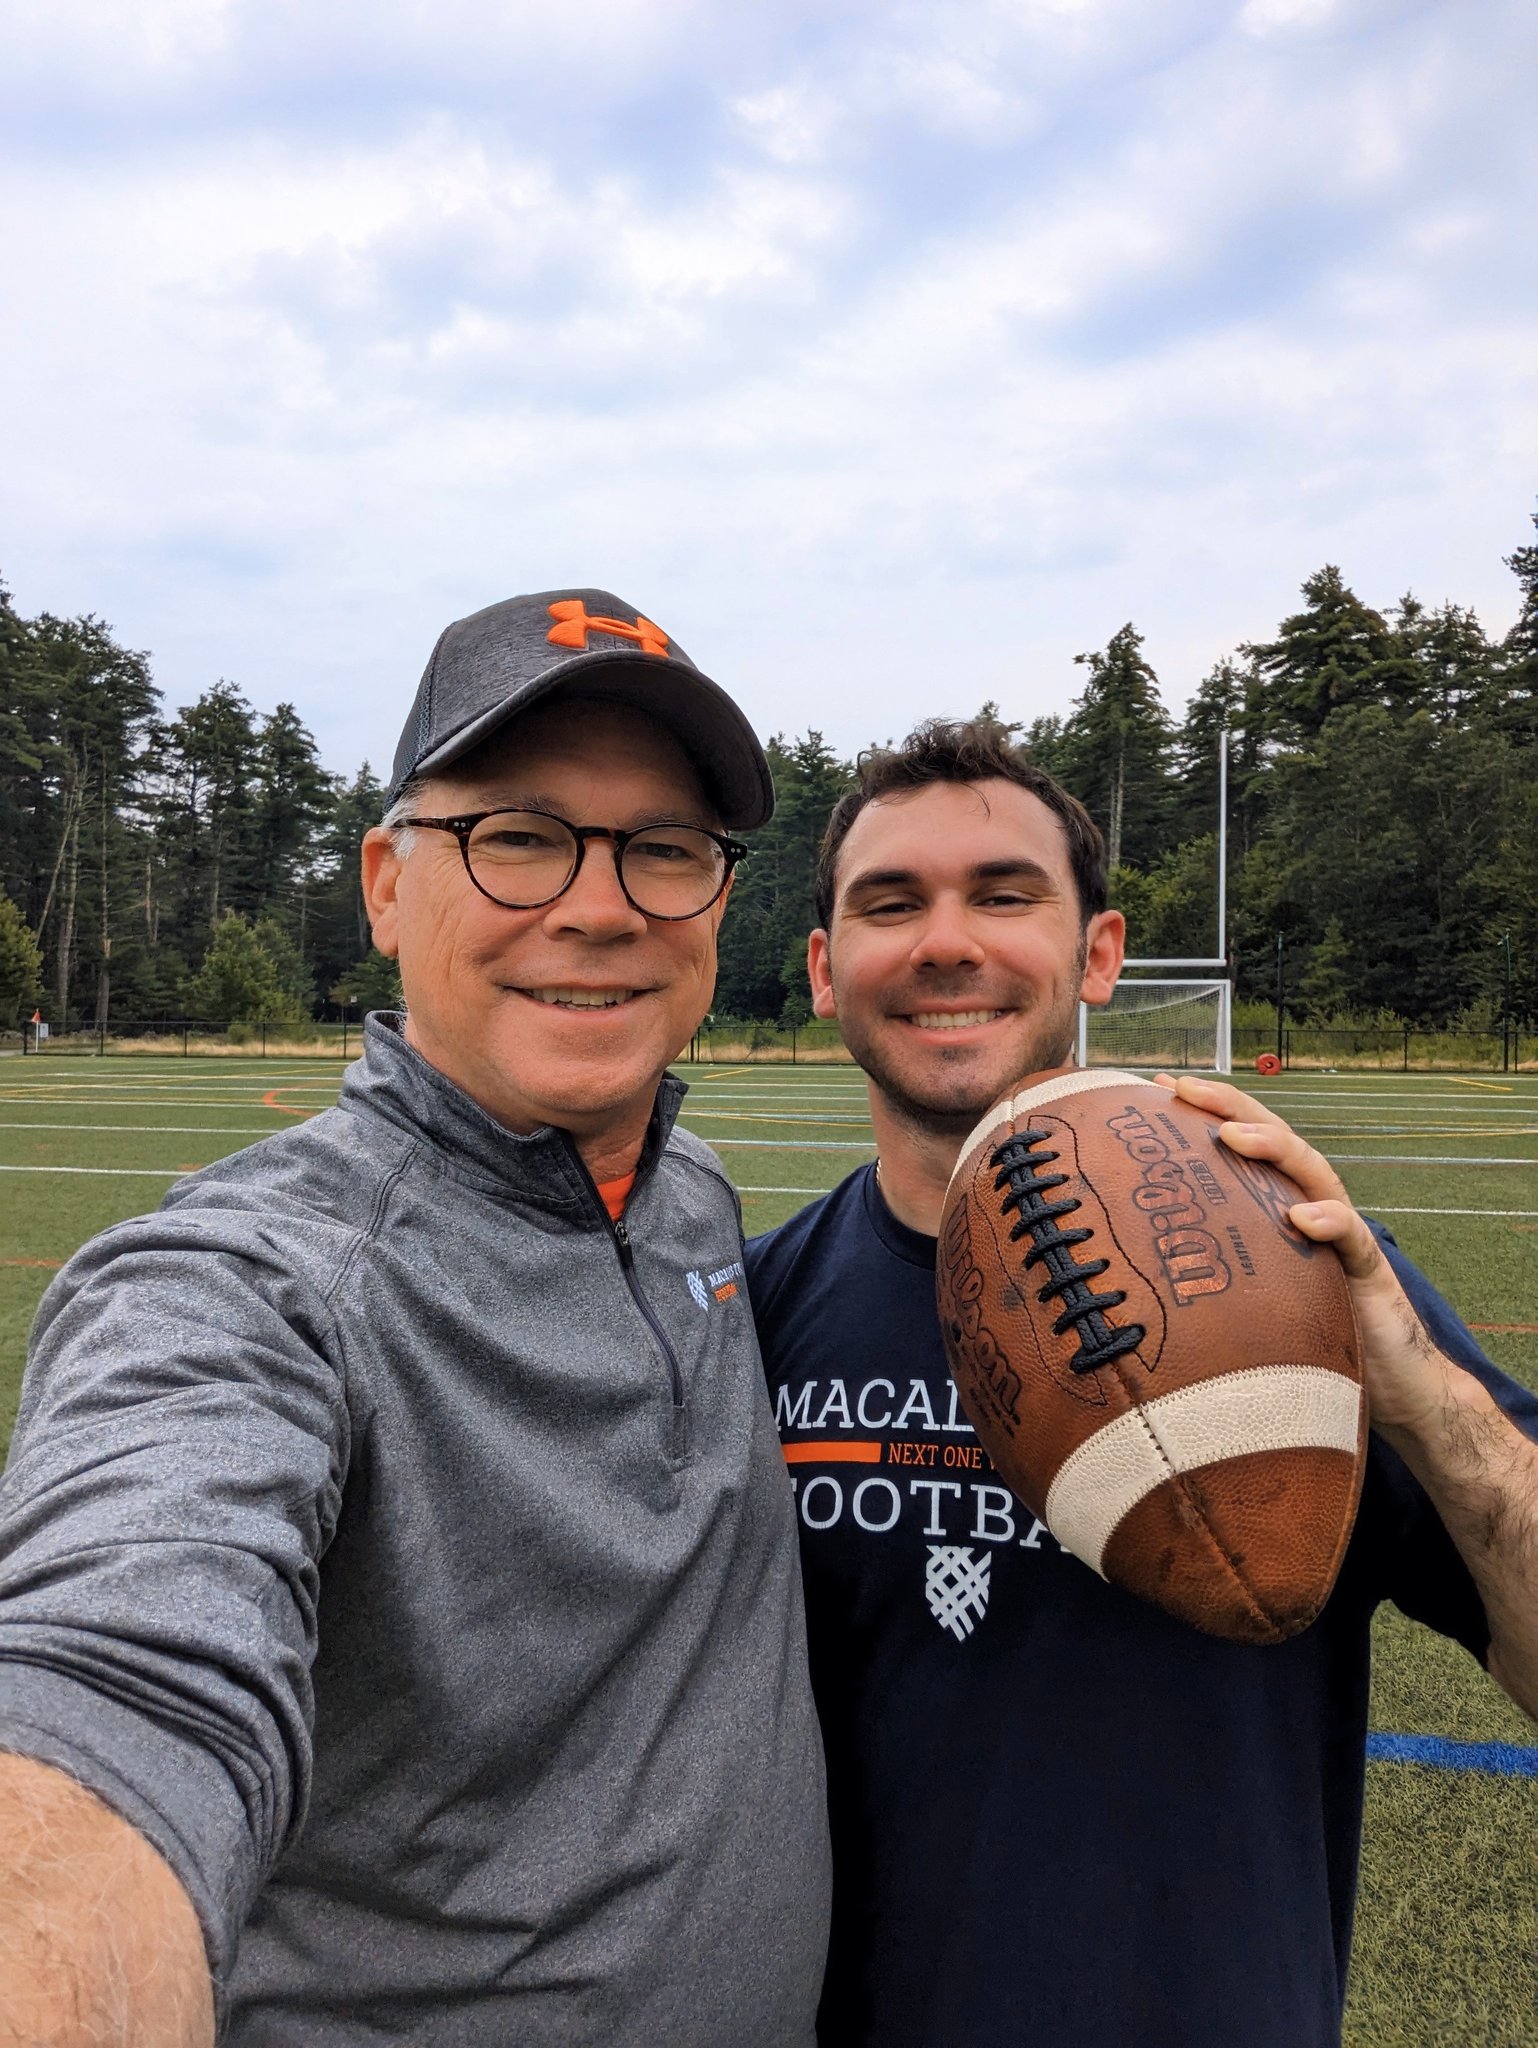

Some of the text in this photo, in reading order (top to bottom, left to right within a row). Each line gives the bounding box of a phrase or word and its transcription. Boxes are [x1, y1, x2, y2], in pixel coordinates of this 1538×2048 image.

[1106, 1107, 1233, 1307] Wilson
[1226, 1225, 1256, 1277] LEATHER
[943, 1193, 1022, 1416] Wilson
[887, 1442, 939, 1467] NEXT
[943, 1446, 983, 1470] ONE
